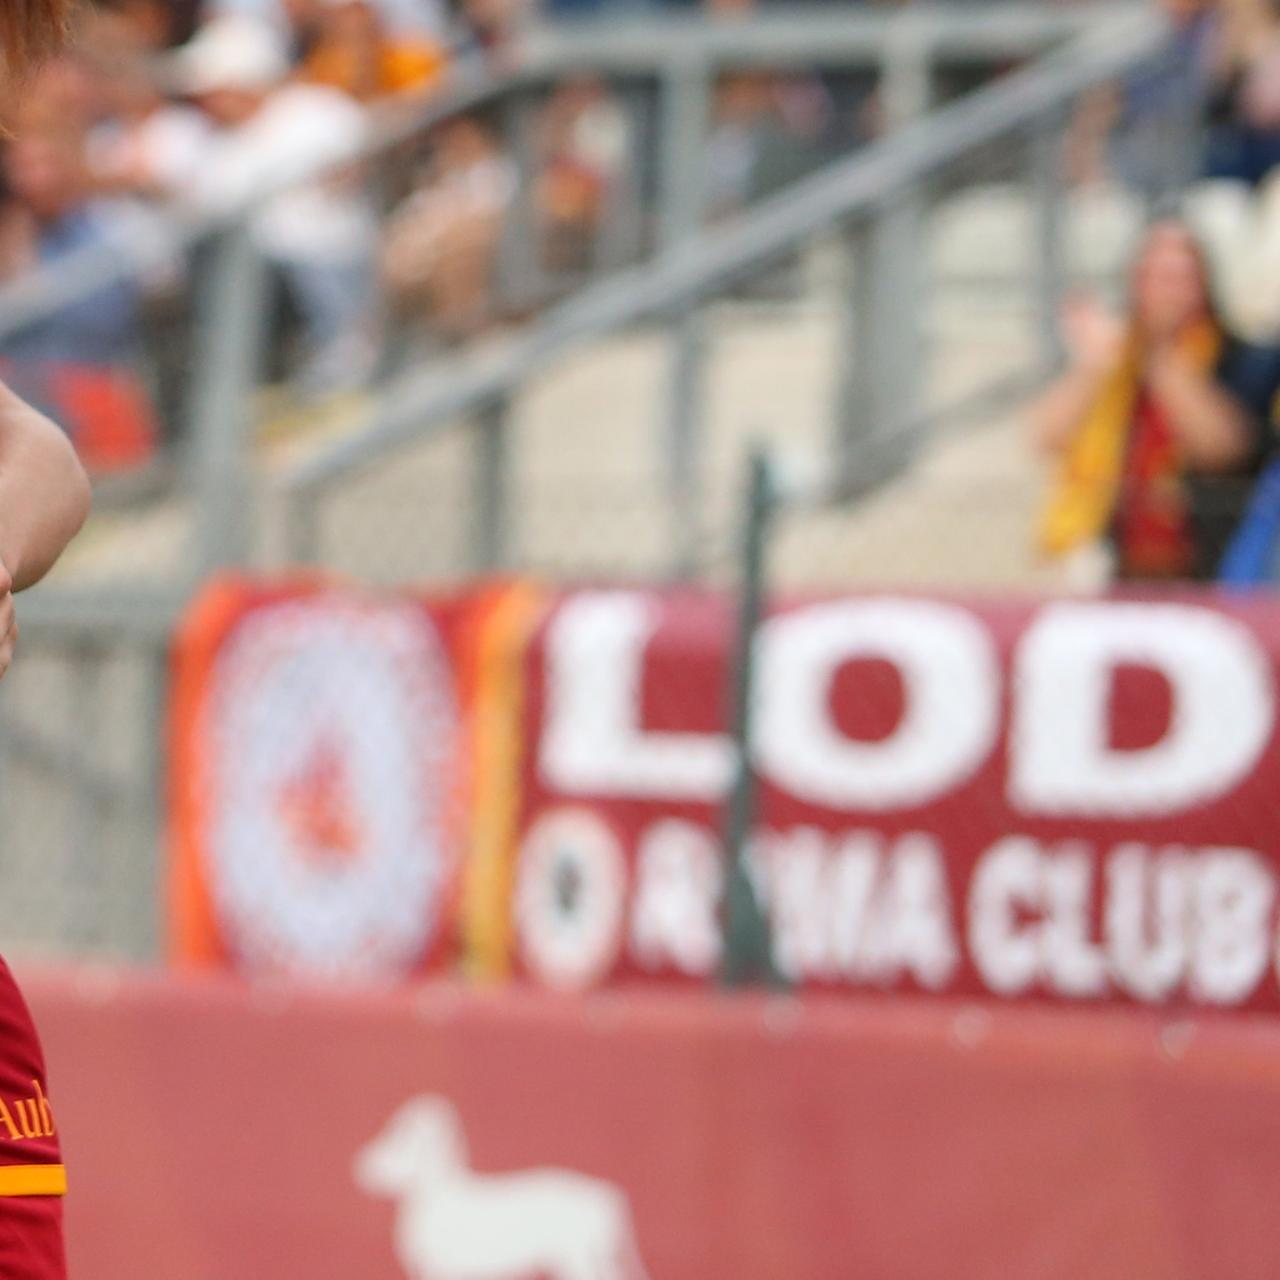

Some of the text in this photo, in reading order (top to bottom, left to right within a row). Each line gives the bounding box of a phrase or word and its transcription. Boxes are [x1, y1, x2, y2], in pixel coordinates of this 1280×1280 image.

[539, 592, 1274, 817] LOD
[632, 820, 1276, 1004] RMA CLUB
